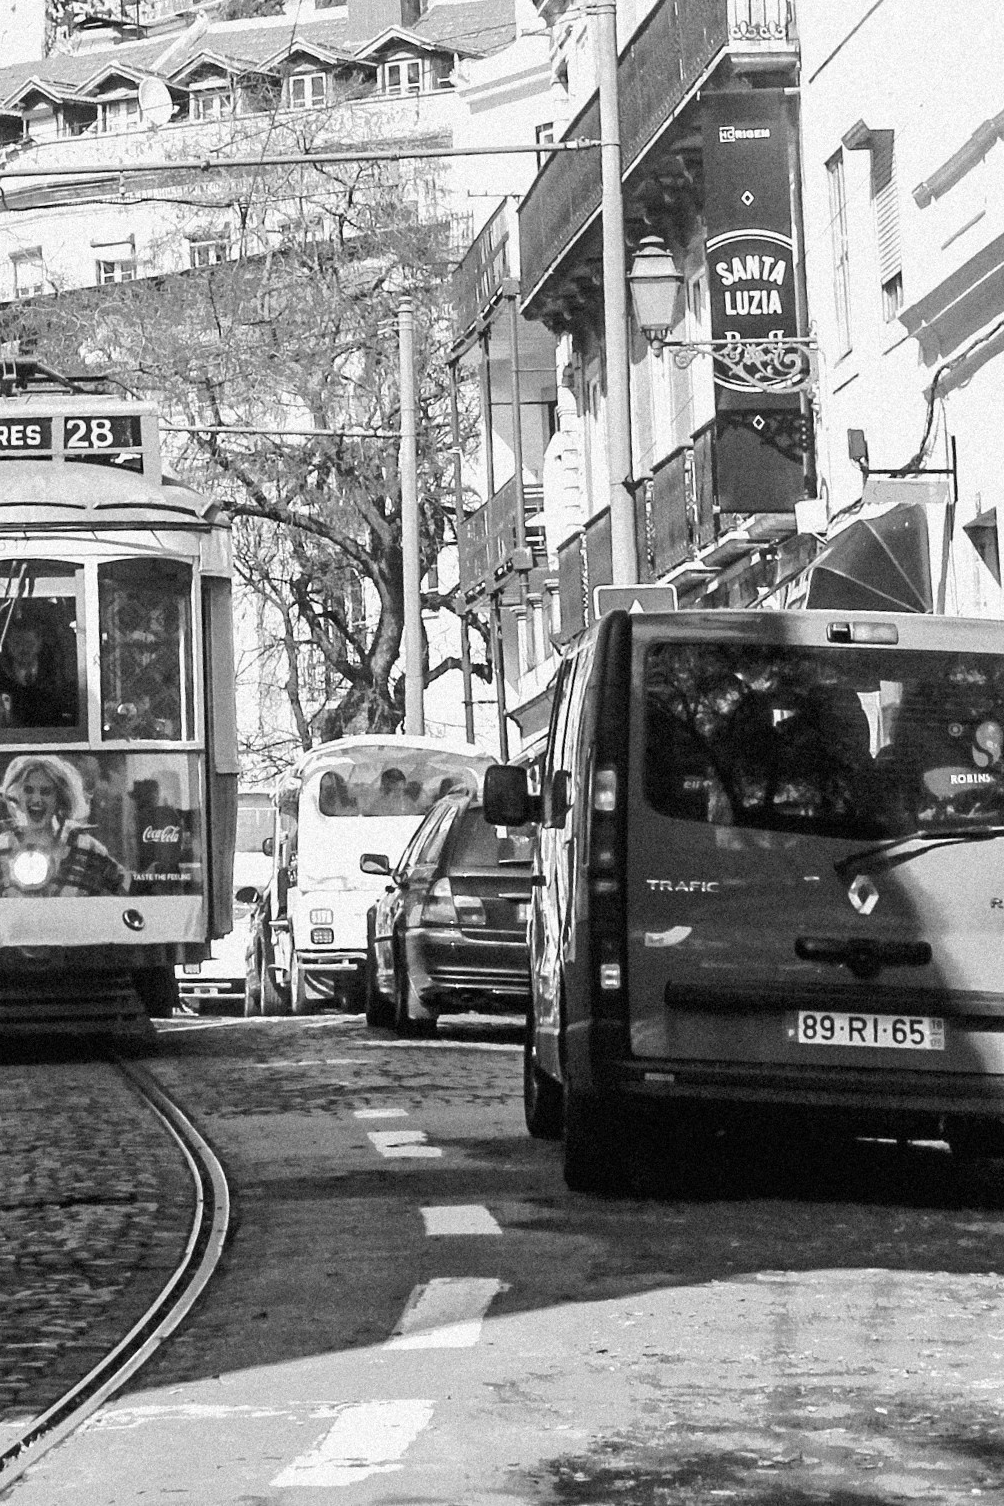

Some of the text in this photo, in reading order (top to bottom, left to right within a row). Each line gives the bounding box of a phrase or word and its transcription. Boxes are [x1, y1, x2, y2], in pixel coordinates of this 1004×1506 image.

[715, 254, 787, 286] SANTA
[724, 289, 783, 316] LUZIA
[66, 419, 115, 448] 28
[646, 879, 720, 893] TRAFIC
